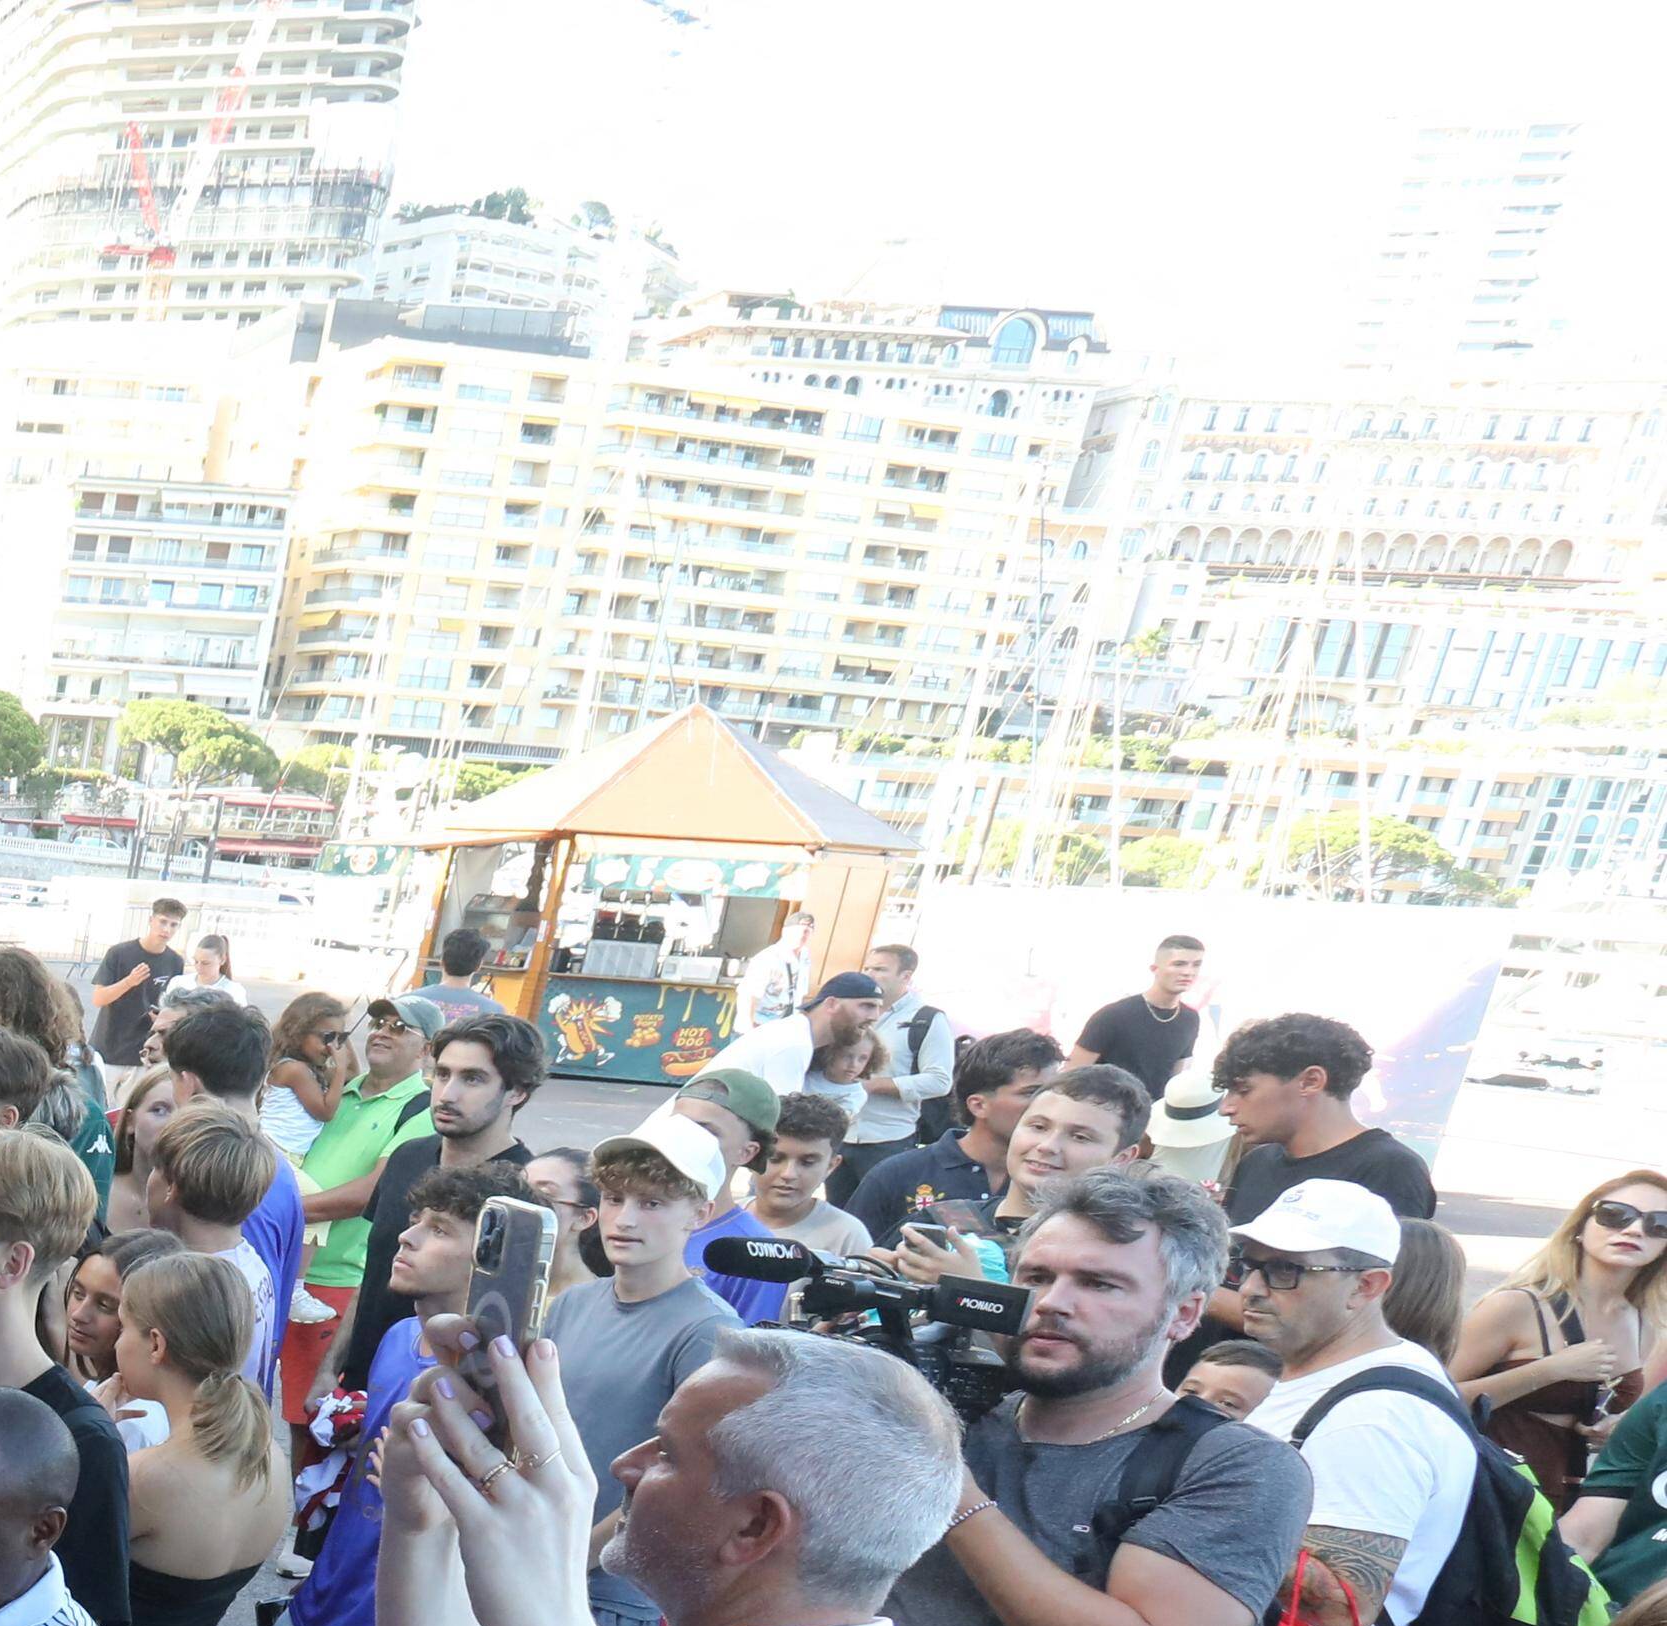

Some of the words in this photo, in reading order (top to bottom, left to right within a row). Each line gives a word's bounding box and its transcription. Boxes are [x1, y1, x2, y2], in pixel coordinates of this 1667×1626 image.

[679, 1027, 708, 1038] HOT
[675, 1037, 705, 1047] DOG
[824, 1277, 847, 1288] SONY
